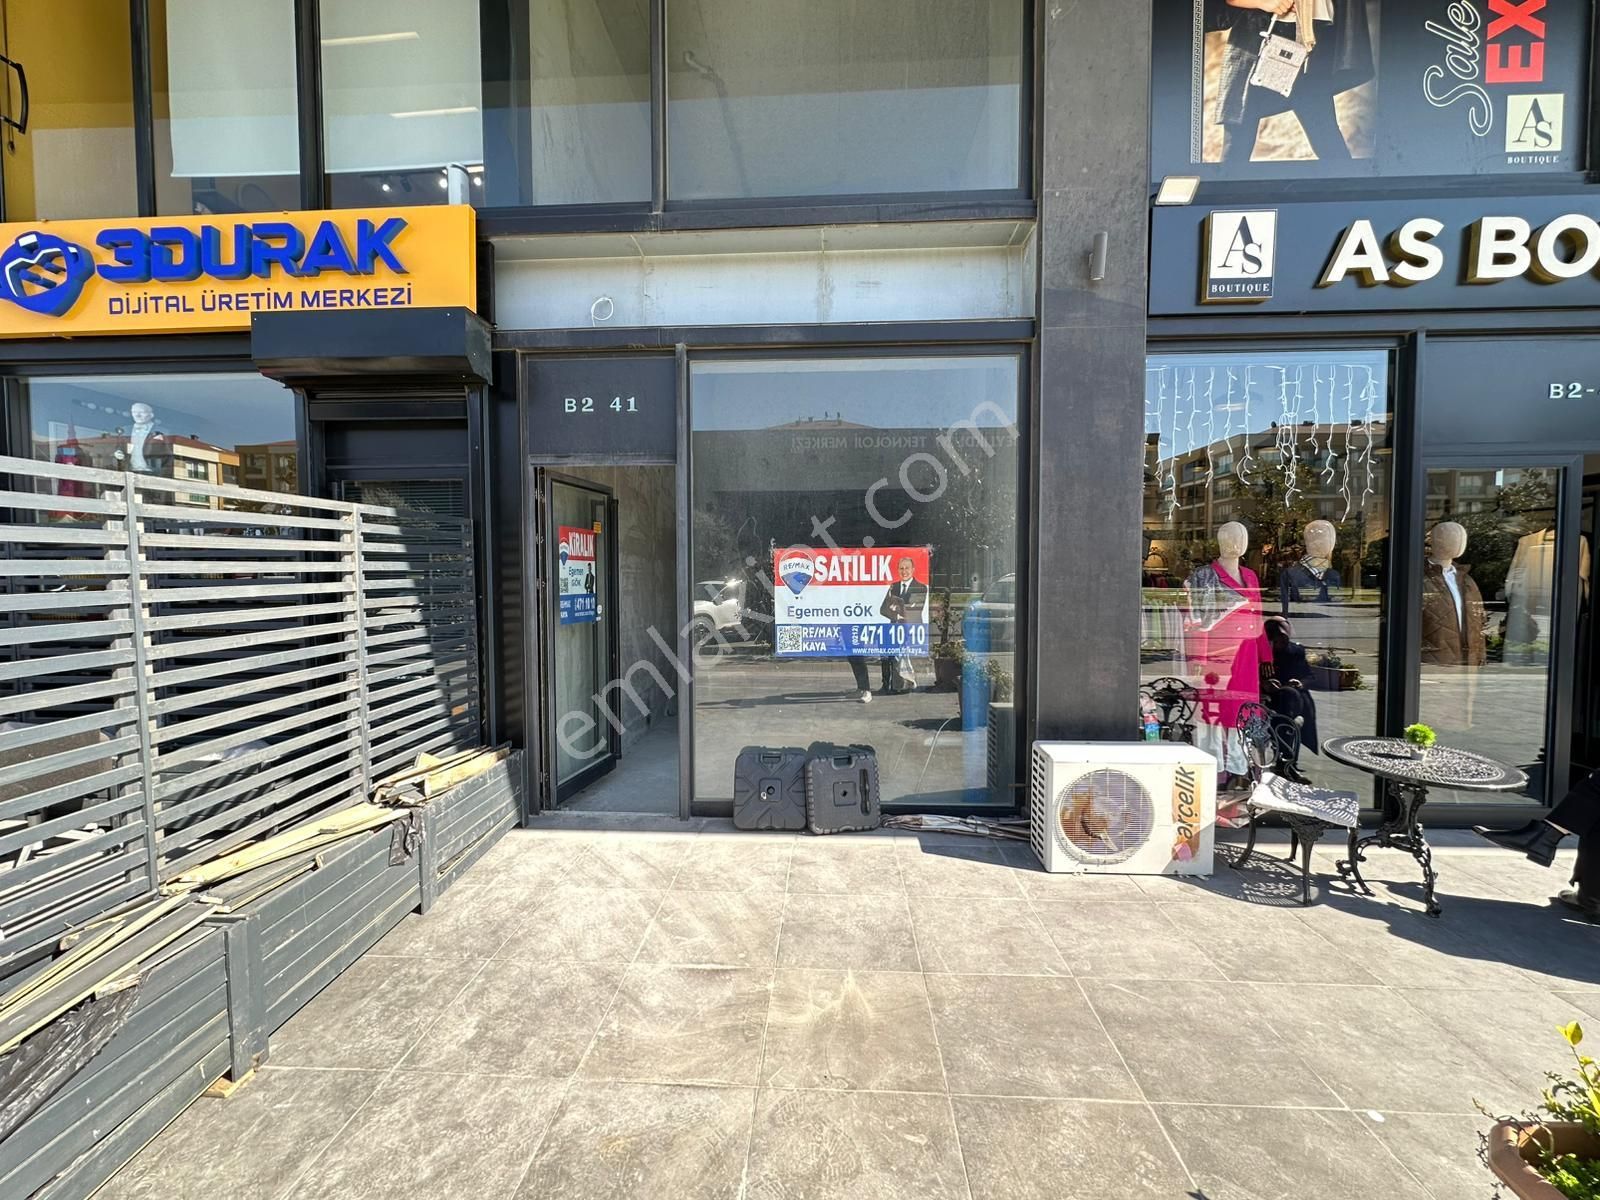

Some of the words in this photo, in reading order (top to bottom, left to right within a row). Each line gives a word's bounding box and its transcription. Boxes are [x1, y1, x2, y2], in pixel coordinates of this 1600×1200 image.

[1423, 0, 1493, 137] Sale
[1507, 155, 1560, 164] BOUTIQUE
[96, 217, 408, 282] 3DURAK
[1324, 218, 1445, 283] AS
[1211, 282, 1270, 293] BOUTIQUE
[109, 292, 194, 315] DİJİTAL
[202, 287, 293, 312] ÜRETİM
[301, 282, 413, 308] MERKEZİ
[1549, 382, 1600, 399] B2-
[564, 397, 594, 413] B2
[610, 396, 639, 412] 41
[783, 561, 811, 571] RE/MAX
[814, 555, 893, 582] SATILIK
[787, 605, 840, 619] Egemen
[843, 603, 873, 617] GÖK
[802, 626, 840, 638] RE/MAX
[860, 625, 884, 645] 471
[889, 625, 905, 645] 10
[909, 625, 925, 645] 10
[802, 642, 827, 652] KAYA
[1174, 766, 1196, 841] arçelik
